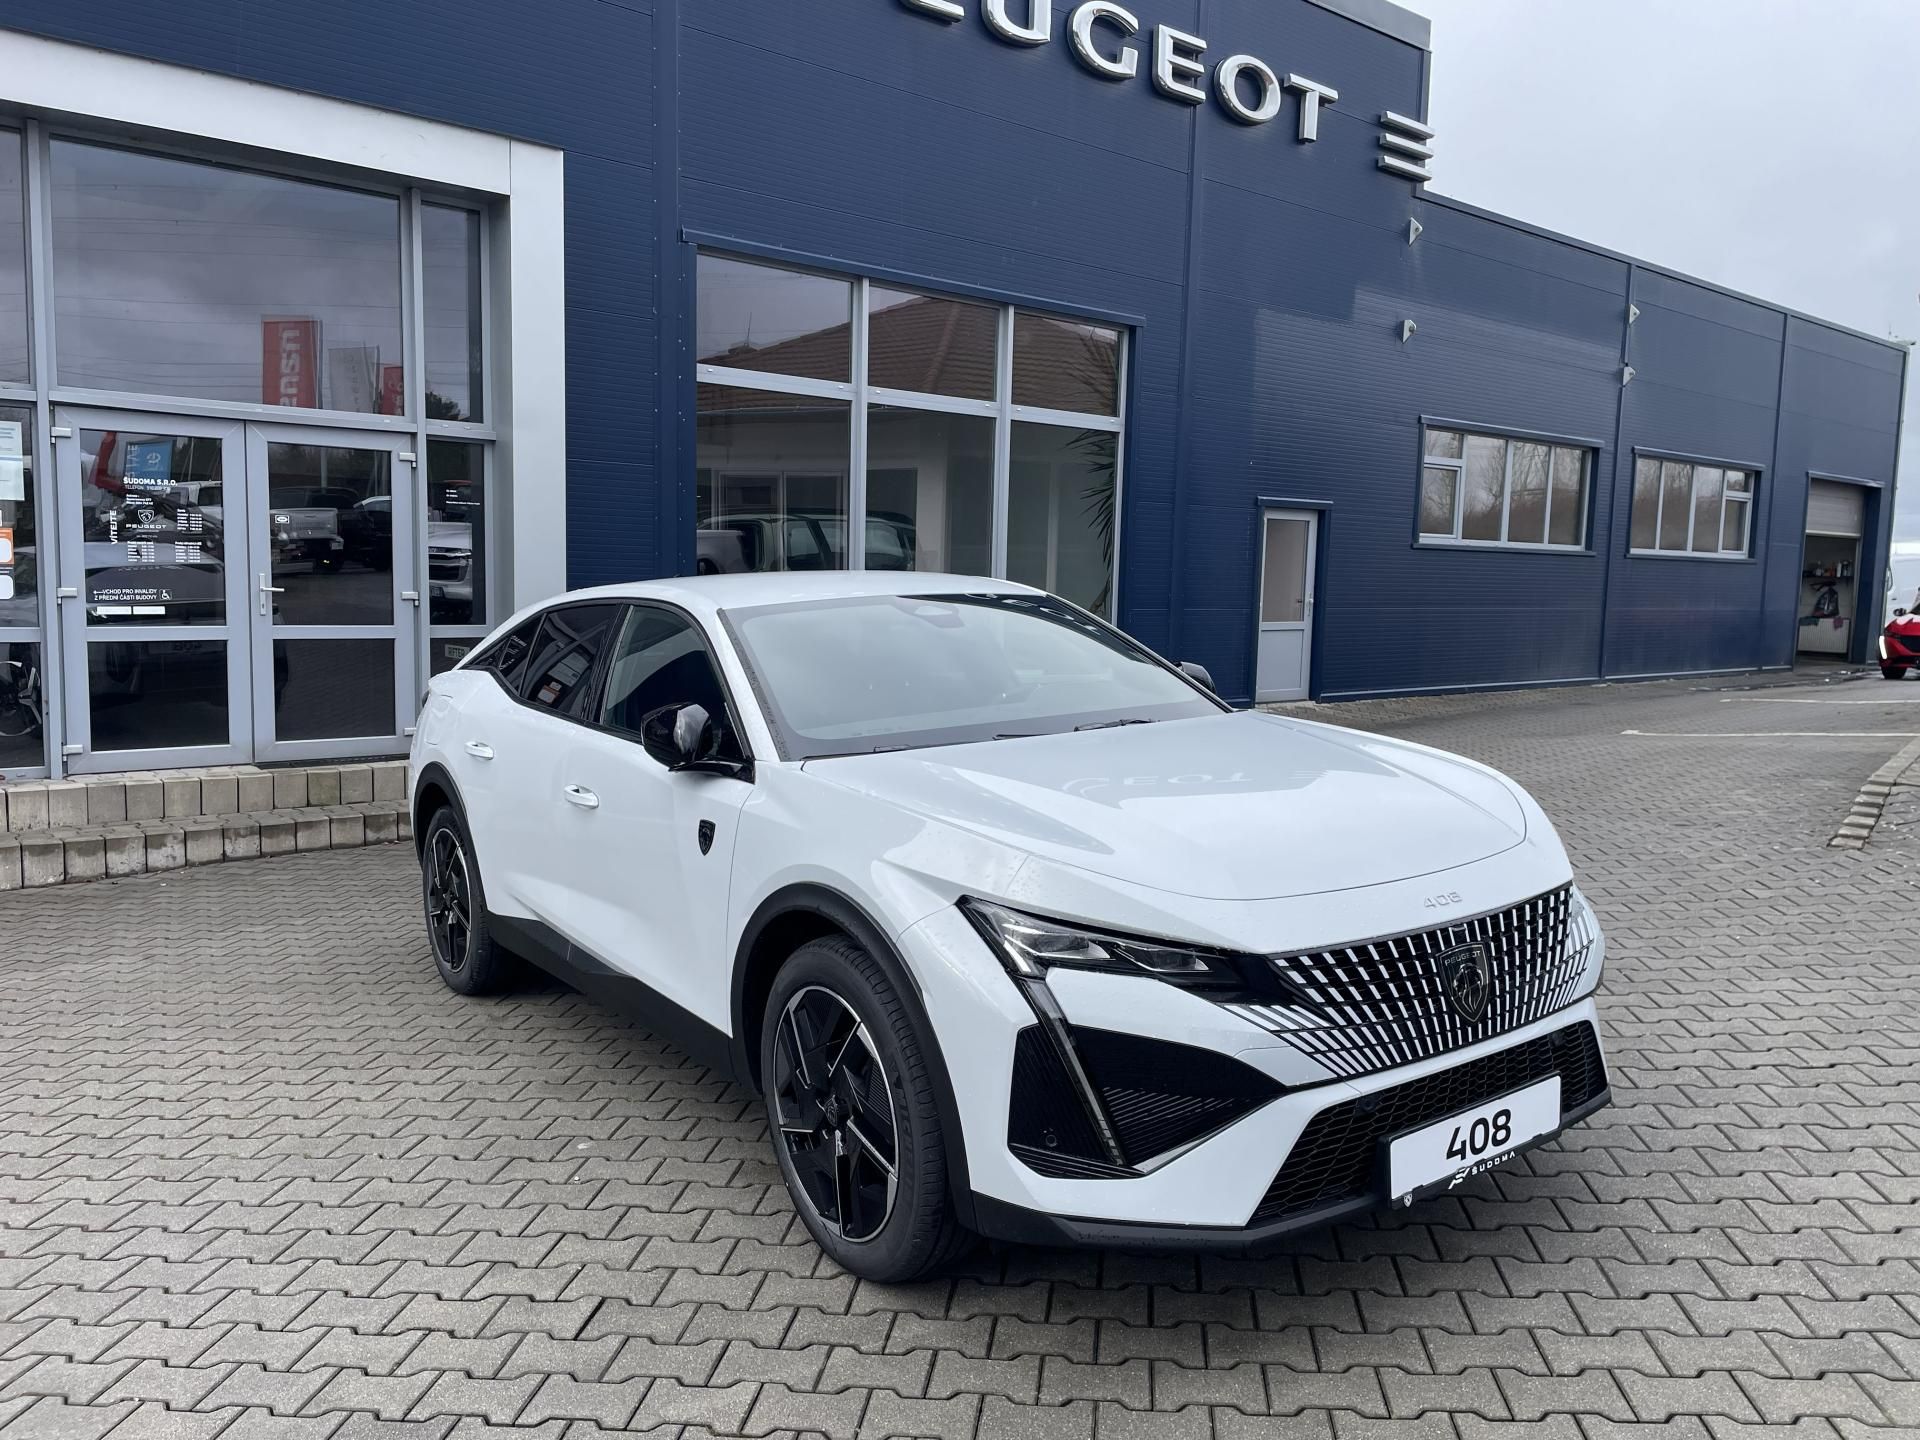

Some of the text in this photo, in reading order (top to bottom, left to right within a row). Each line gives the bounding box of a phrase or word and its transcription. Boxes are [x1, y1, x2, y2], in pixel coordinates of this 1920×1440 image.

[900, 0, 1339, 144] UGEOT
[123, 476, 156, 485] ŠUDOMA
[1424, 891, 1463, 908] 408
[1444, 950, 1481, 966] PEUGEOT
[1446, 1108, 1513, 1162] 408
